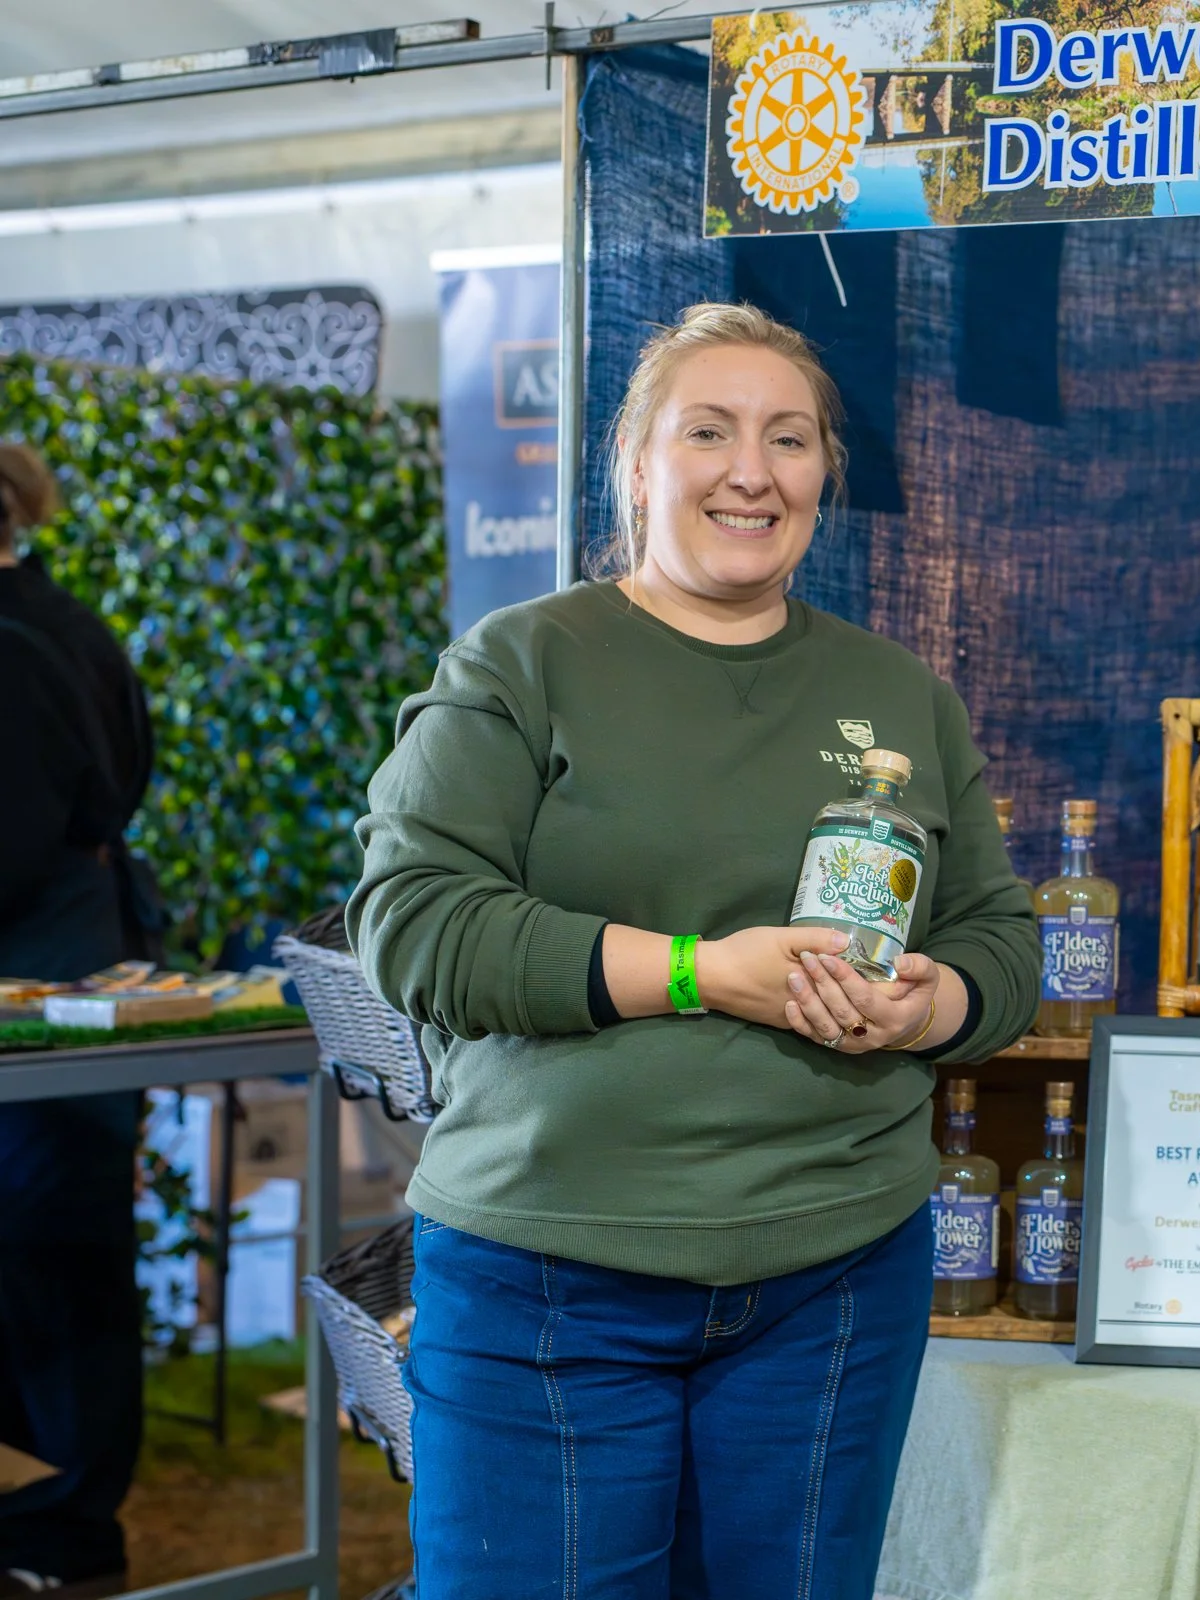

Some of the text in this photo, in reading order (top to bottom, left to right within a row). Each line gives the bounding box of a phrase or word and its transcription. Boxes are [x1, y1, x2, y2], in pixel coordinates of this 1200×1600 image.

[772, 57, 825, 75] ROTARY
[751, 147, 843, 191] INTERNATIONAL
[855, 863, 888, 886] Last
[821, 875, 902, 915] Sanctuary
[846, 903, 871, 918] ORGANIC
[1045, 931, 1107, 956] Elder
[1156, 1146, 1192, 1160] BEST
[932, 1209, 980, 1233] lder
[1020, 1213, 1081, 1238] Elder
[933, 1230, 982, 1252] lower
[1163, 1259, 1183, 1269] THE
